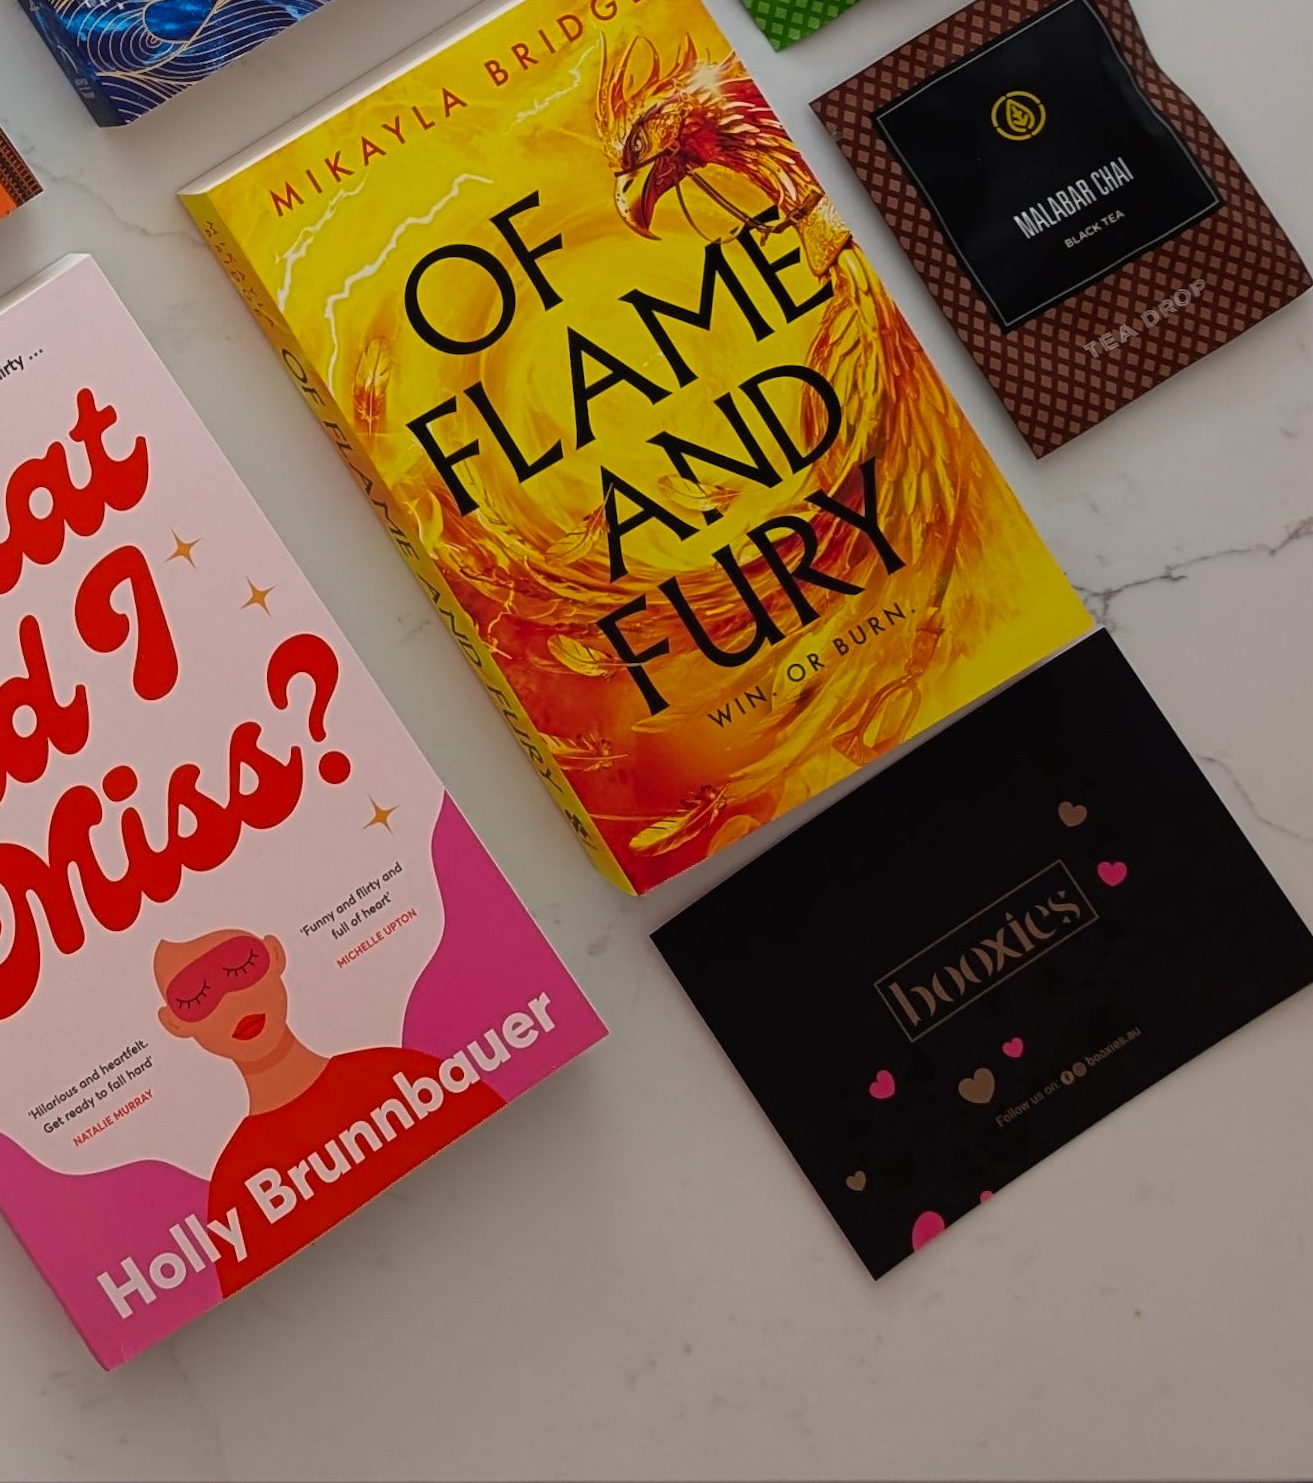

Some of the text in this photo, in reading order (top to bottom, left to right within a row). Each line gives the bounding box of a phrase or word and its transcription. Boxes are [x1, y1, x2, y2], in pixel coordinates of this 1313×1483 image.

[269, 86, 468, 217] MIKAYLA
[1012, 155, 1135, 239] MALABAR CHAI
[404, 190, 563, 355] OF
[1063, 208, 1126, 249] BLACK TEA
[406, 204, 835, 516] FLAME
[600, 364, 843, 582] AND
[73, 544, 179, 701] I
[595, 455, 906, 716] FURY
[706, 601, 916, 728] WIN. OR BURN.
[336, 907, 418, 969] MICHELLE UPTON
[72, 1087, 153, 1148] NATALIE MURRAY
[96, 992, 555, 1319] Holly Brunnbauer
